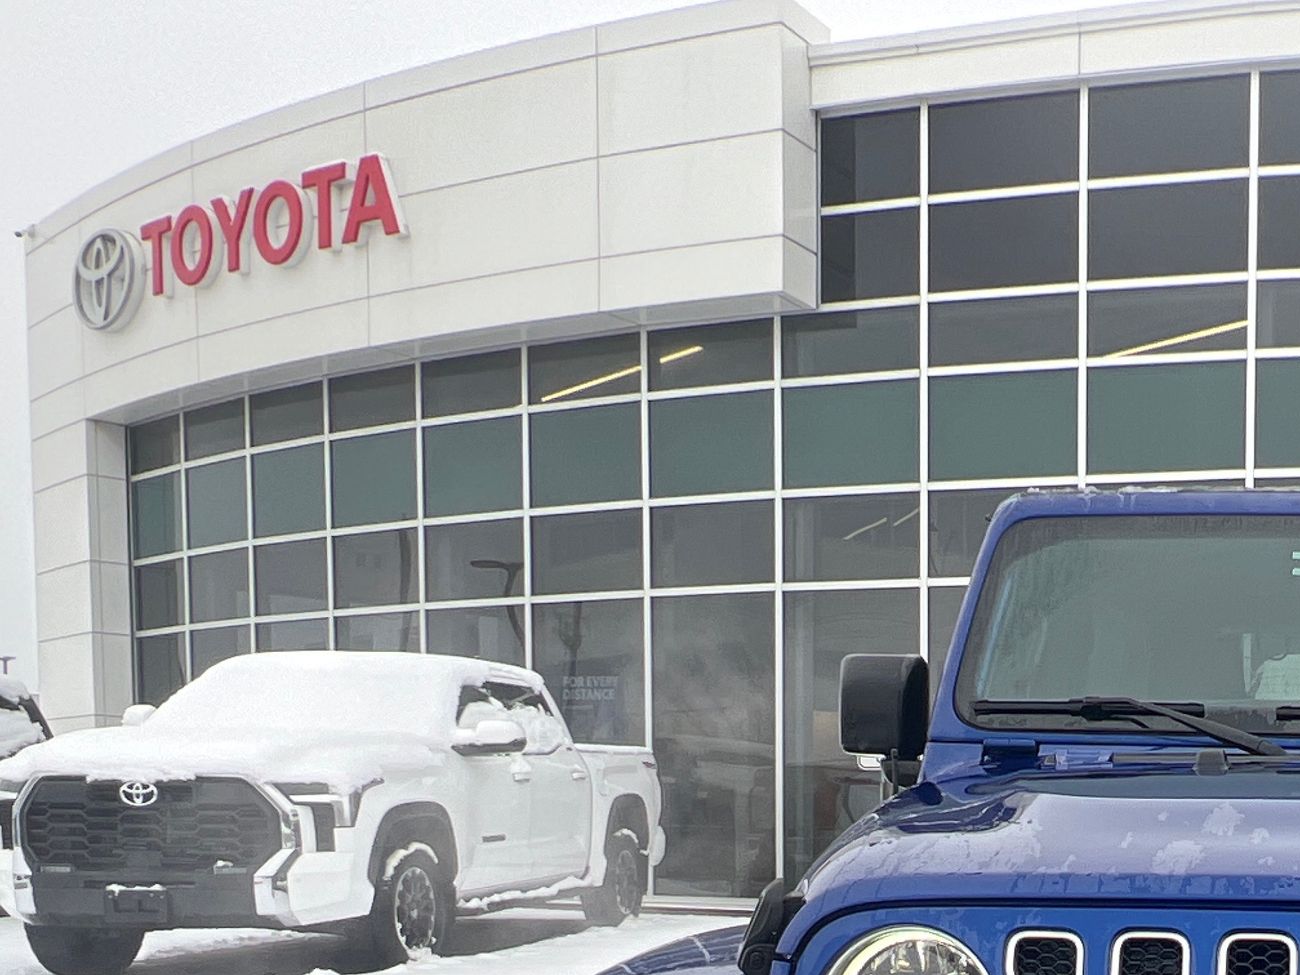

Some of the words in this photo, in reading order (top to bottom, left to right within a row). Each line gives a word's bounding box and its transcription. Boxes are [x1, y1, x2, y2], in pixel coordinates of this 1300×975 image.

[141, 153, 403, 296] TOYOTA
[562, 675, 585, 688] FOR
[562, 688, 616, 701] DISTANCE
